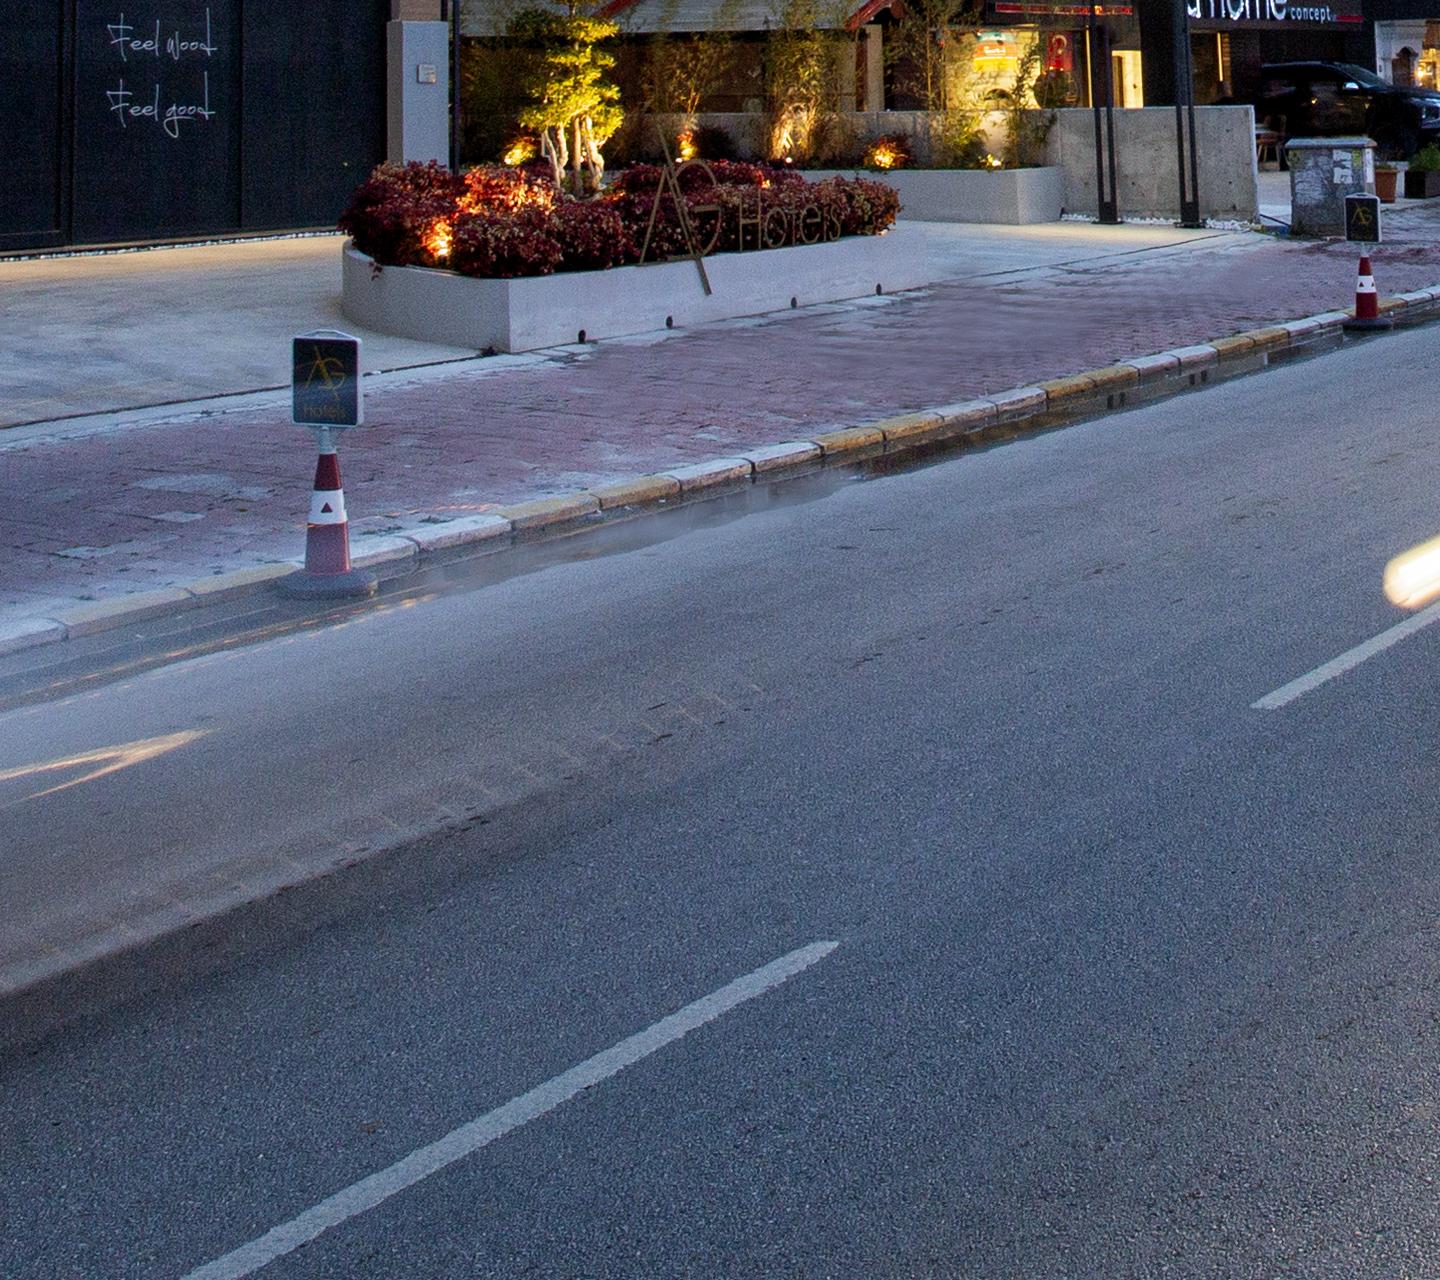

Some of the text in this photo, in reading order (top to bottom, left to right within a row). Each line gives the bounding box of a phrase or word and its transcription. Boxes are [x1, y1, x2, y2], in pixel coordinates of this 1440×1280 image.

[106, 7, 218, 63] Feel wood
[1291, 5, 1331, 24] concept
[106, 71, 216, 138] Feel good
[738, 191, 842, 253] Hotels
